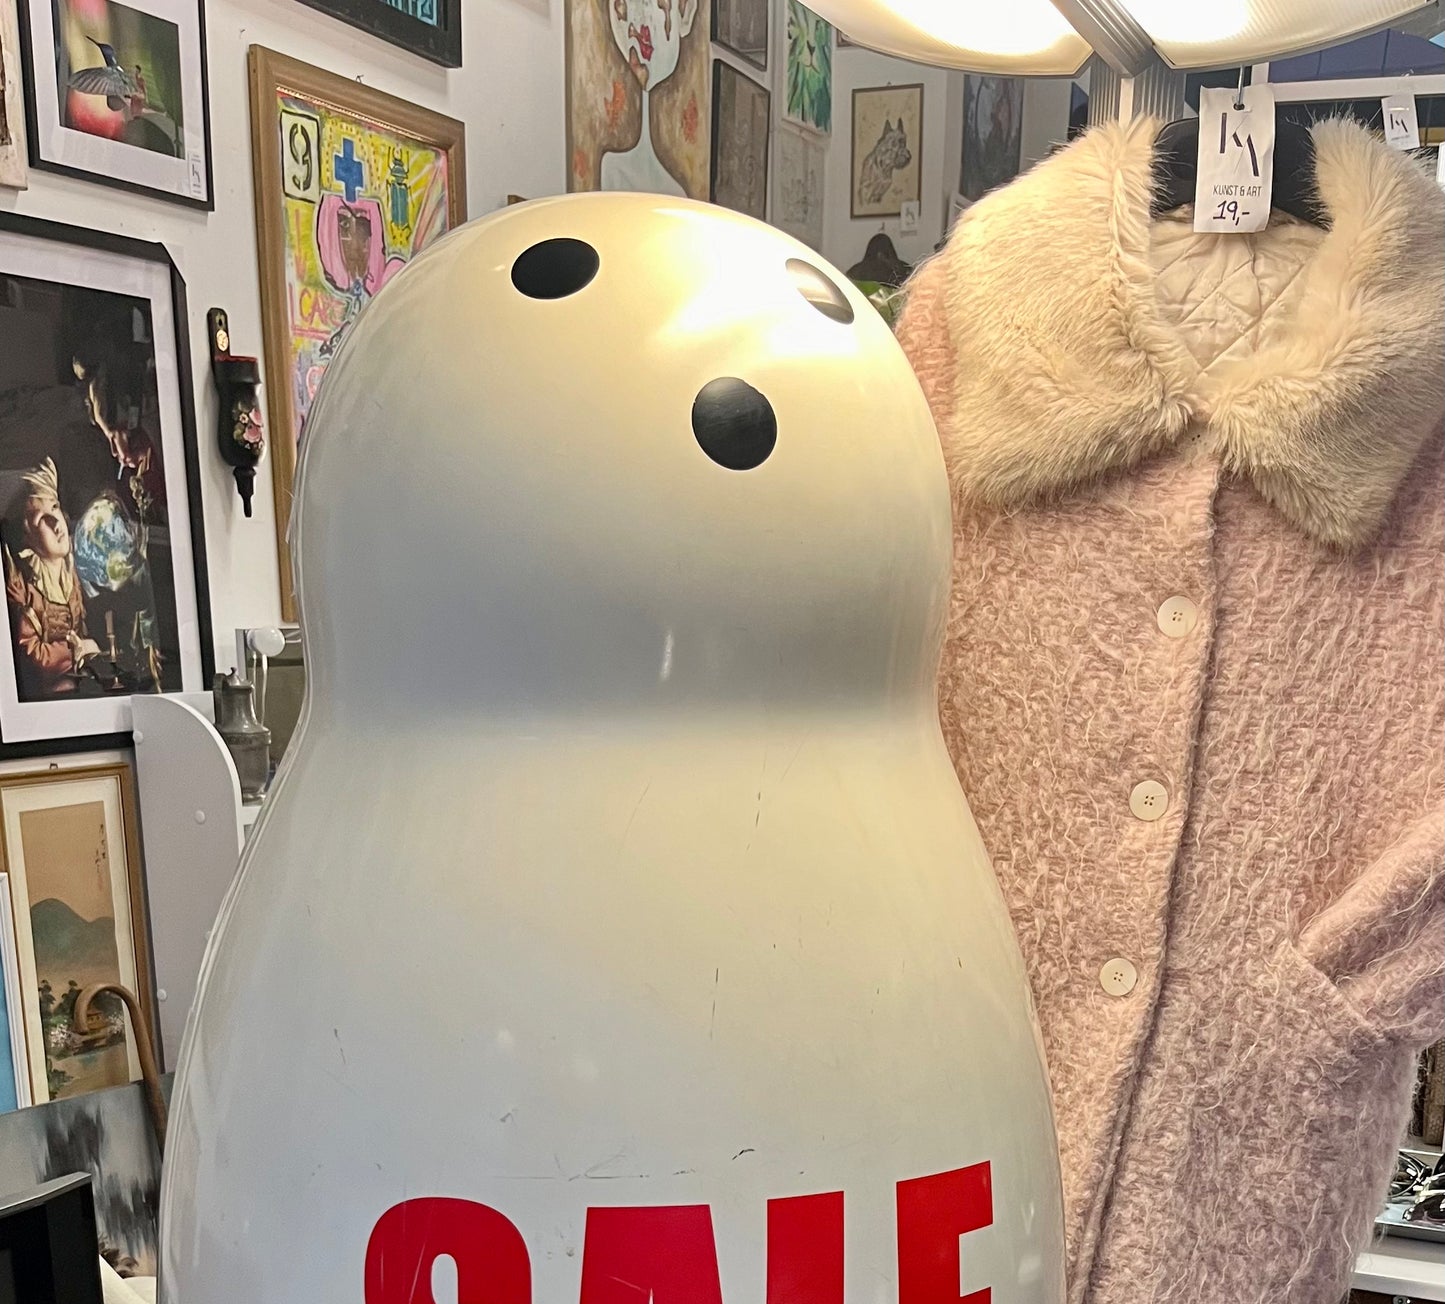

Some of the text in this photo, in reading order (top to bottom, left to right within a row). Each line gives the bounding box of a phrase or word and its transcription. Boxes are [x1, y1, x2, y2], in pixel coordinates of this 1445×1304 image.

[289, 122, 312, 191] 9
[1212, 184, 1262, 197] KUNST & ART
[1212, 200, 1250, 226] 19,-
